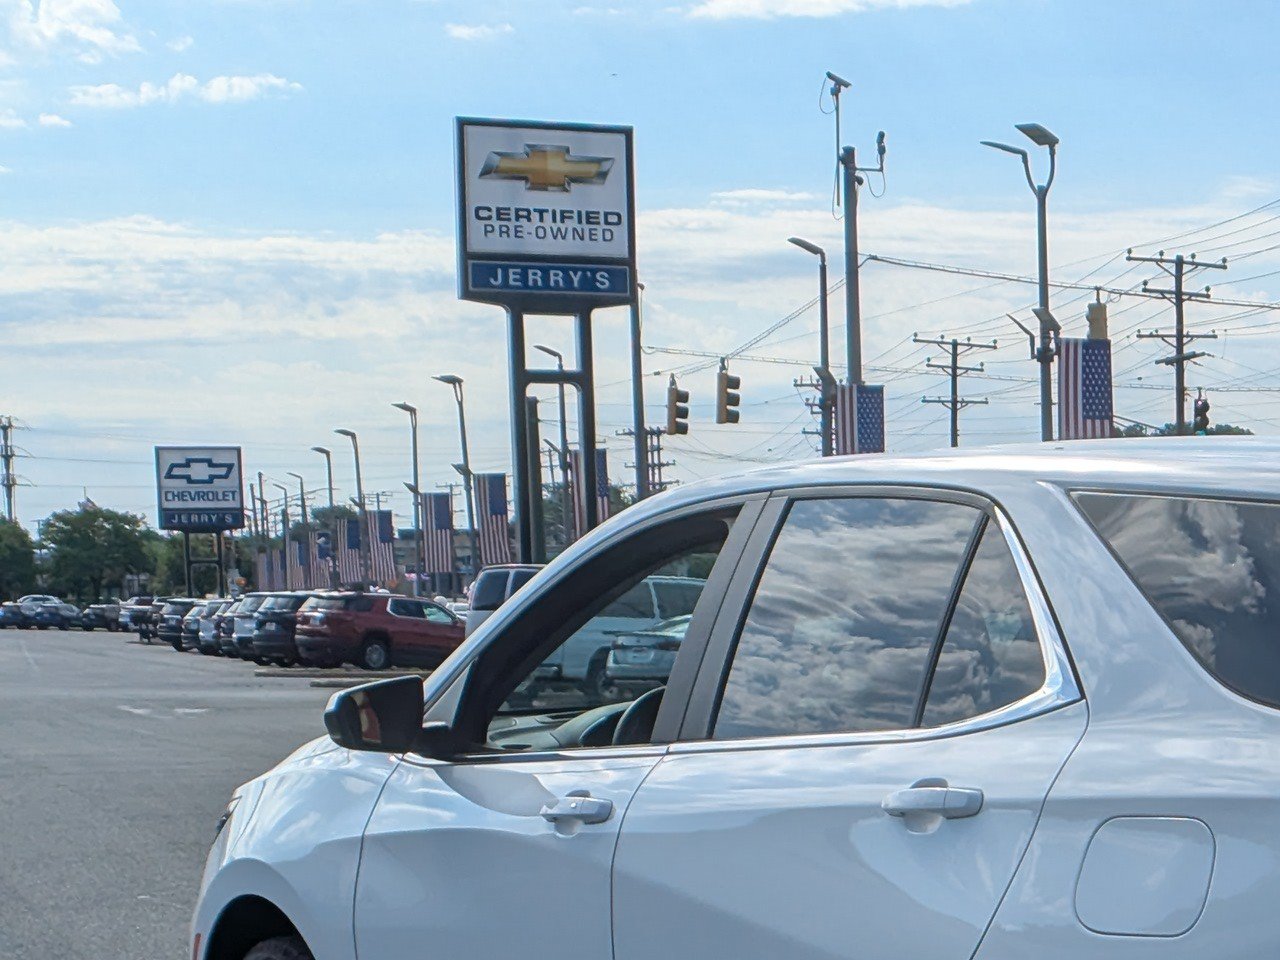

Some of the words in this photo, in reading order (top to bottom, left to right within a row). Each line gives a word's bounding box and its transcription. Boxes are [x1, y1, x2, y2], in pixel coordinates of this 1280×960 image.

[474, 205, 623, 227] CERTIFIED
[483, 223, 615, 243] PRE-OWNED
[488, 267, 612, 290] JERRY'S
[164, 490, 237, 503] CHEVROLET
[171, 513, 233, 523] JERRY'S
